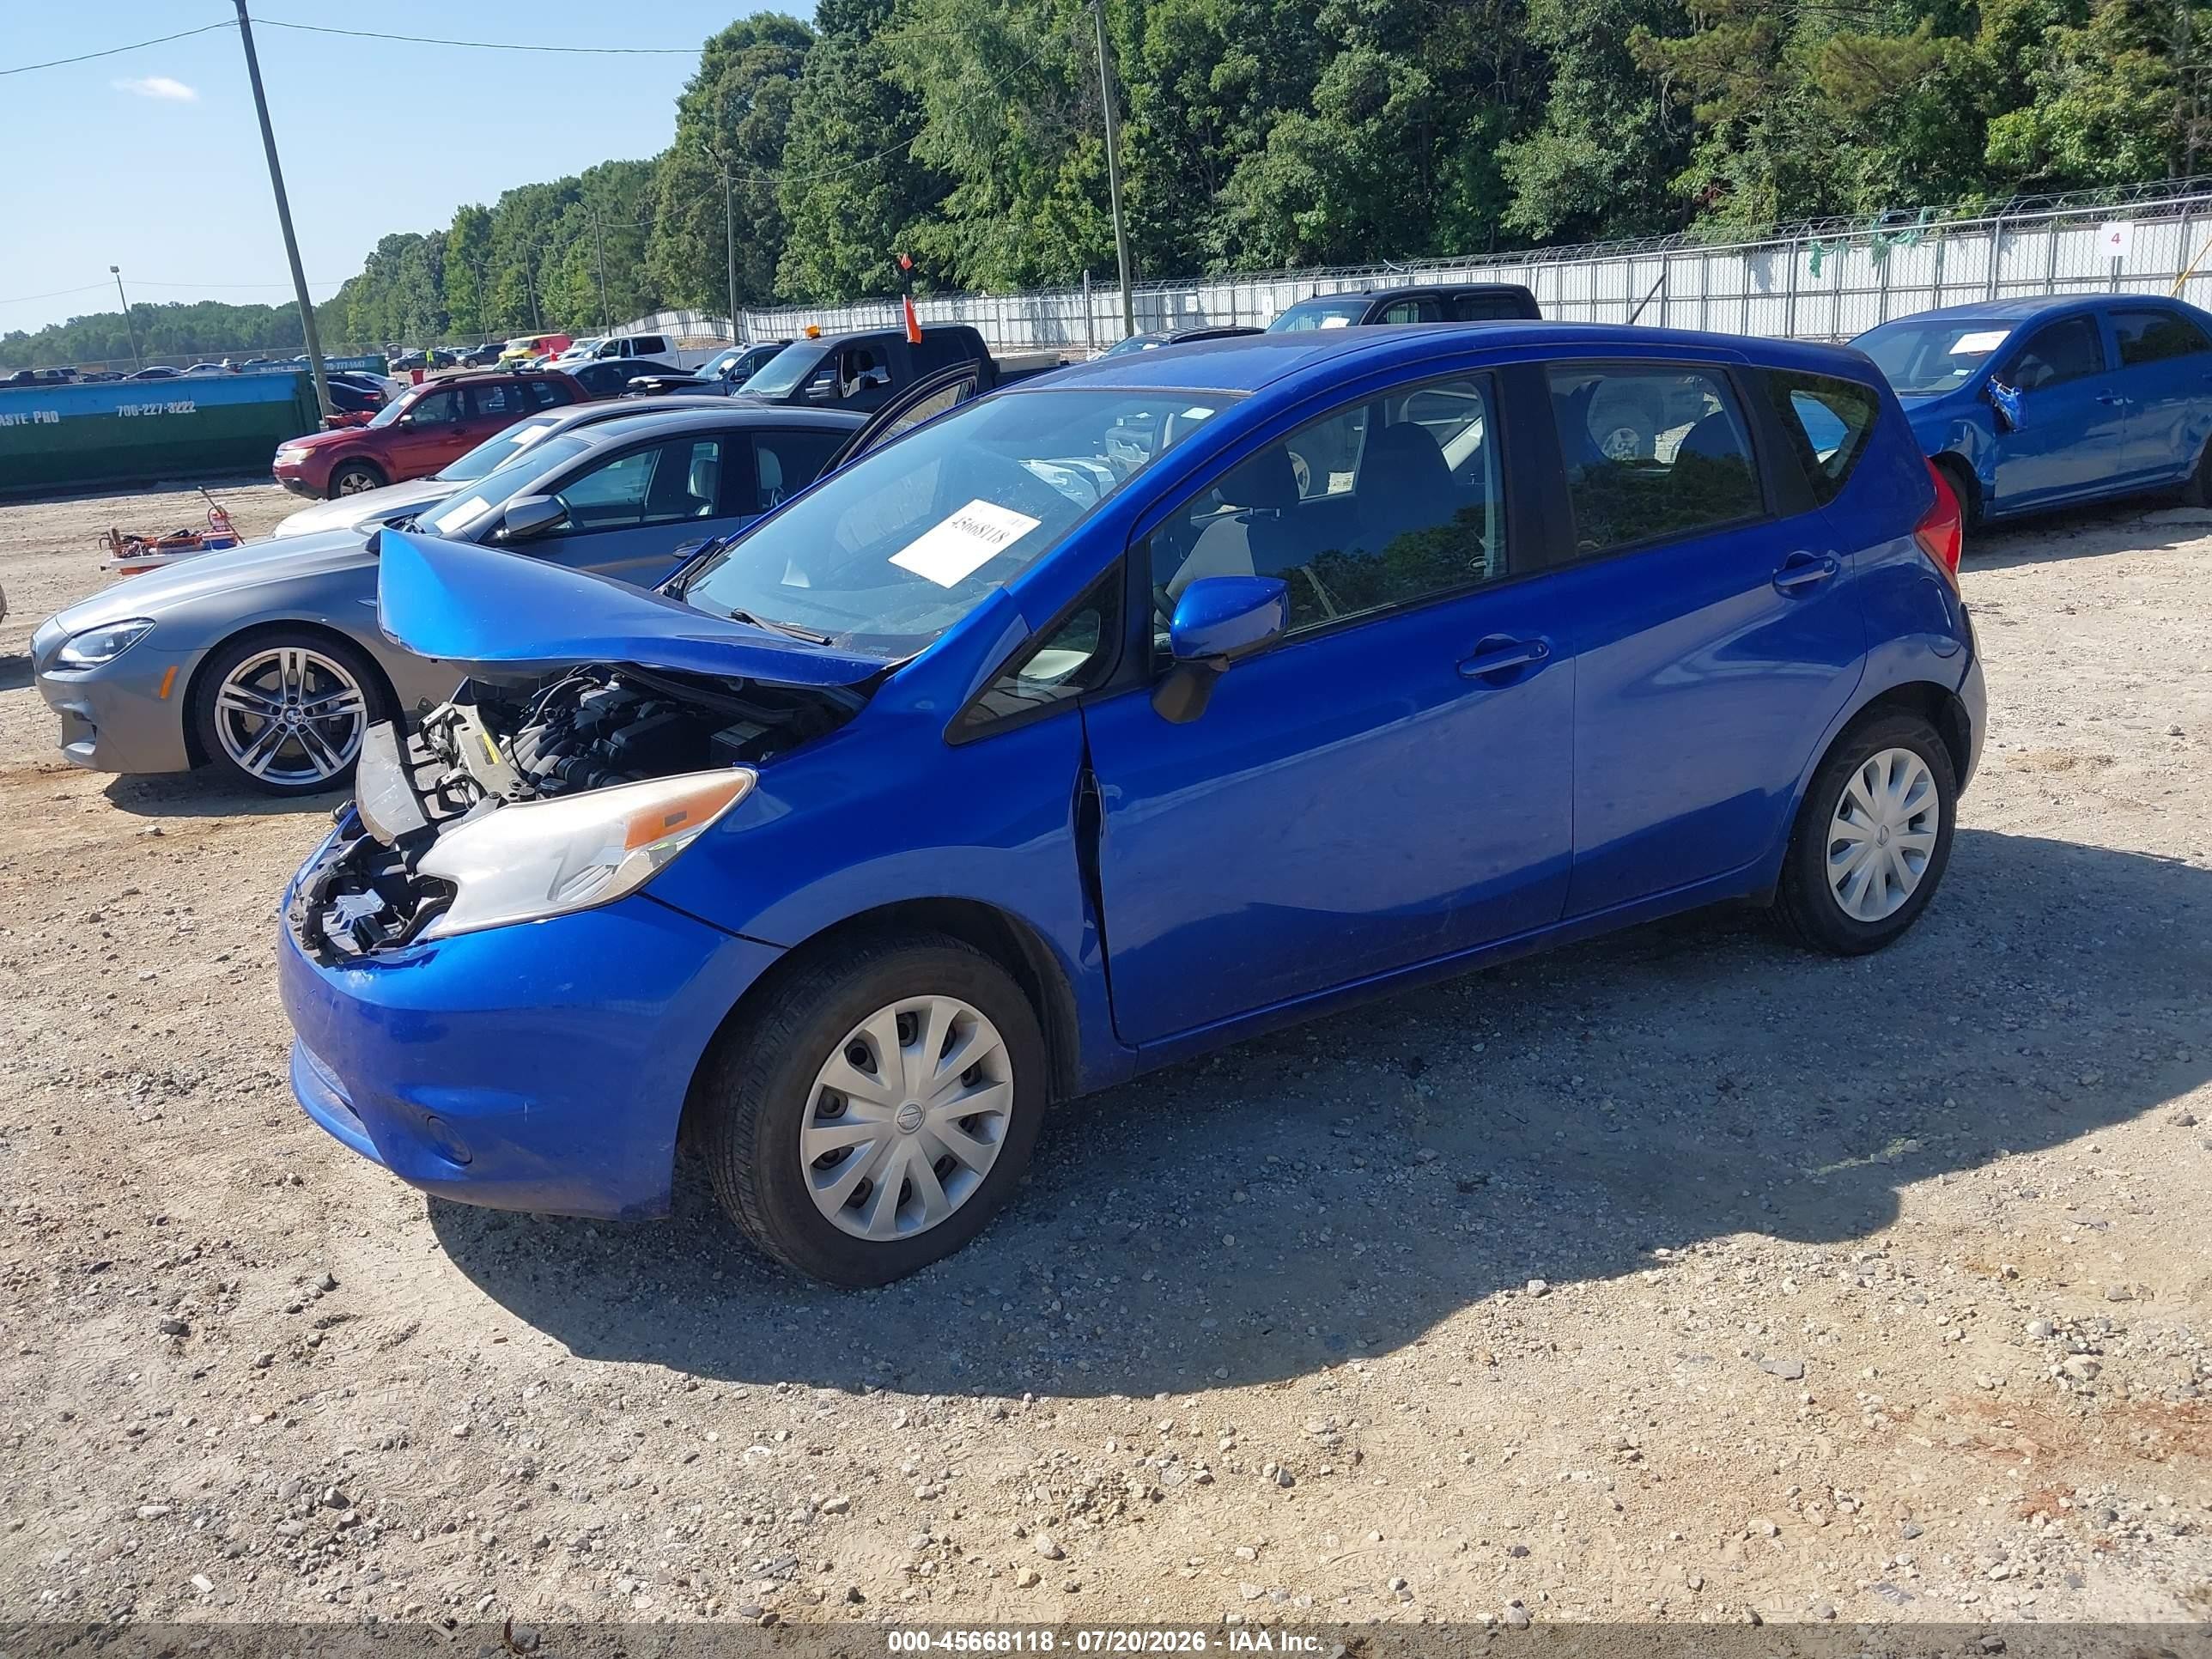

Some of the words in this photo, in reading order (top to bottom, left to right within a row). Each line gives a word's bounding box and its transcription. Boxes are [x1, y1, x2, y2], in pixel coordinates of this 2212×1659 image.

[2111, 233, 2122, 245] 4
[33, 410, 59, 423] PRO
[951, 516, 1011, 544] 45668118
